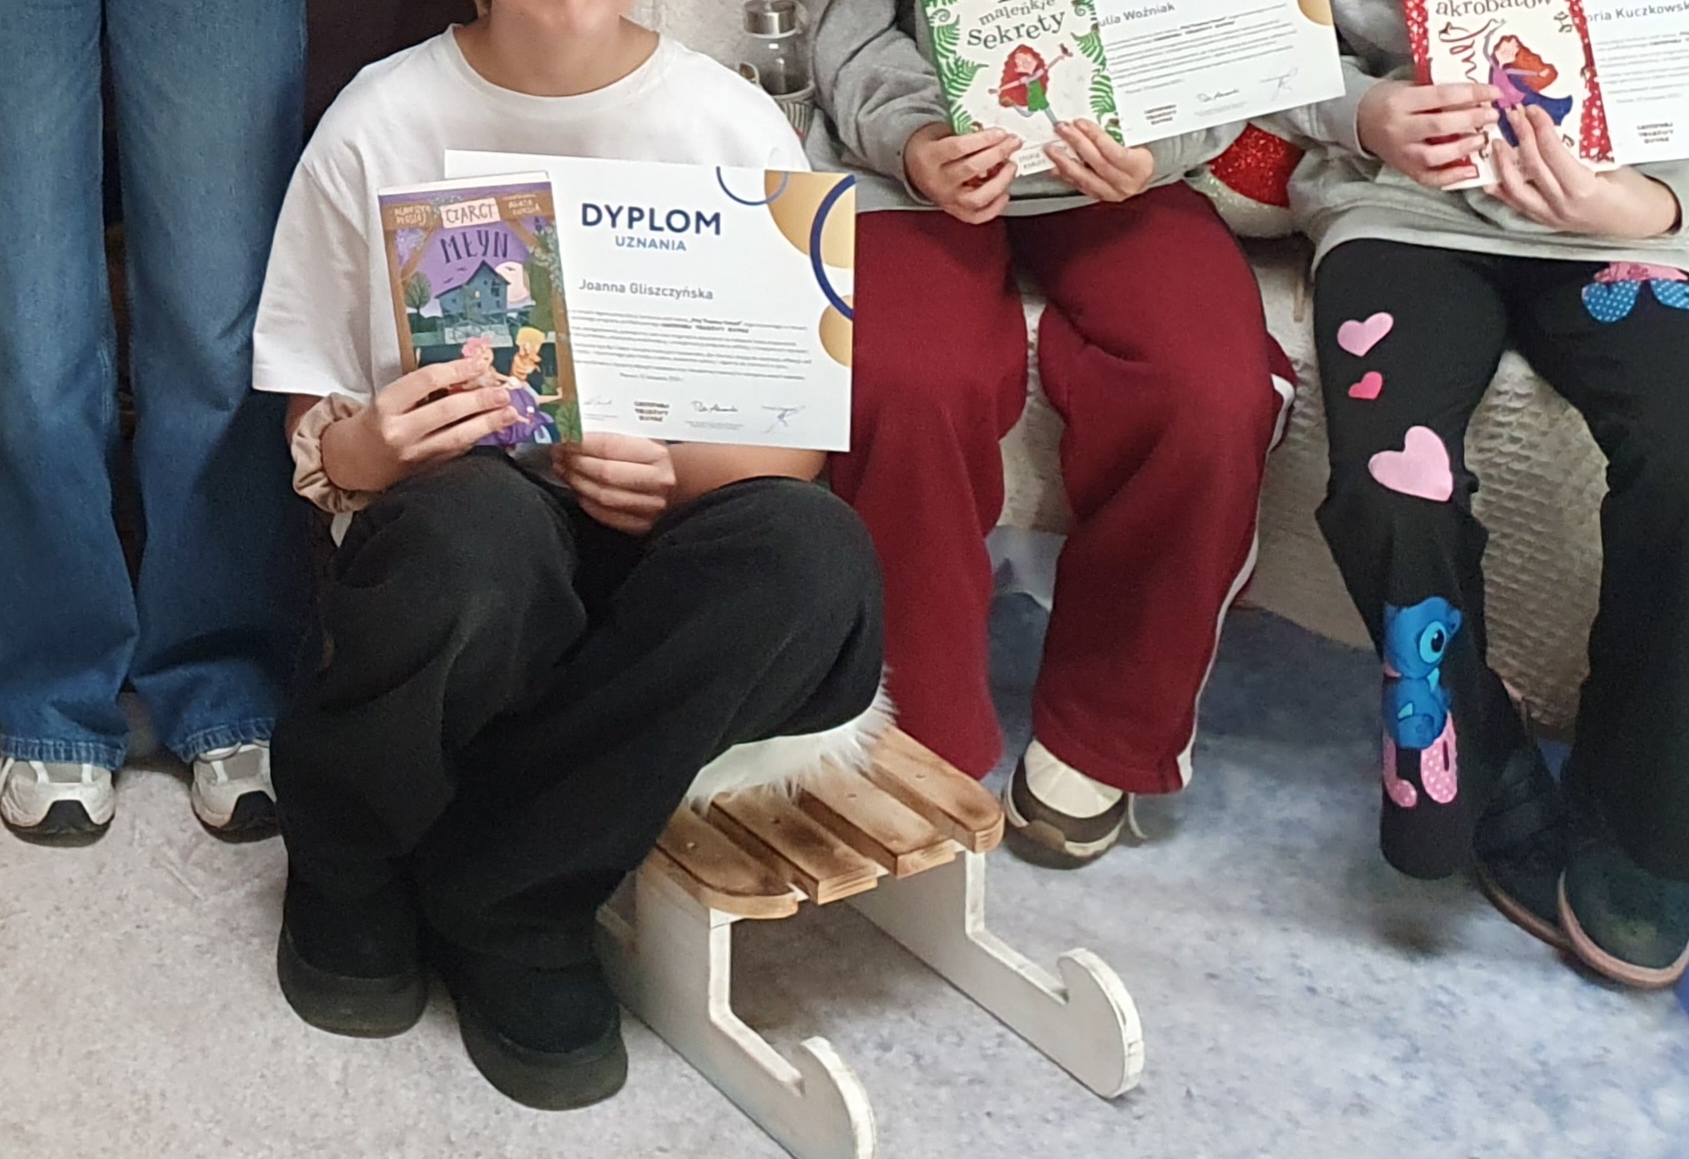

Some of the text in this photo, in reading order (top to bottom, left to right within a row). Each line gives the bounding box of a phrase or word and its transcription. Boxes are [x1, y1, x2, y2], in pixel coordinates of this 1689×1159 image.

[1615, 0, 1689, 19] Kuczkowsk
[1098, 15, 1121, 27] ulia
[582, 203, 721, 236] DYPLOM
[440, 229, 509, 264] MŁYN
[615, 235, 687, 251] UZNANIA
[579, 279, 714, 300] Joanna Gliszczyńska
